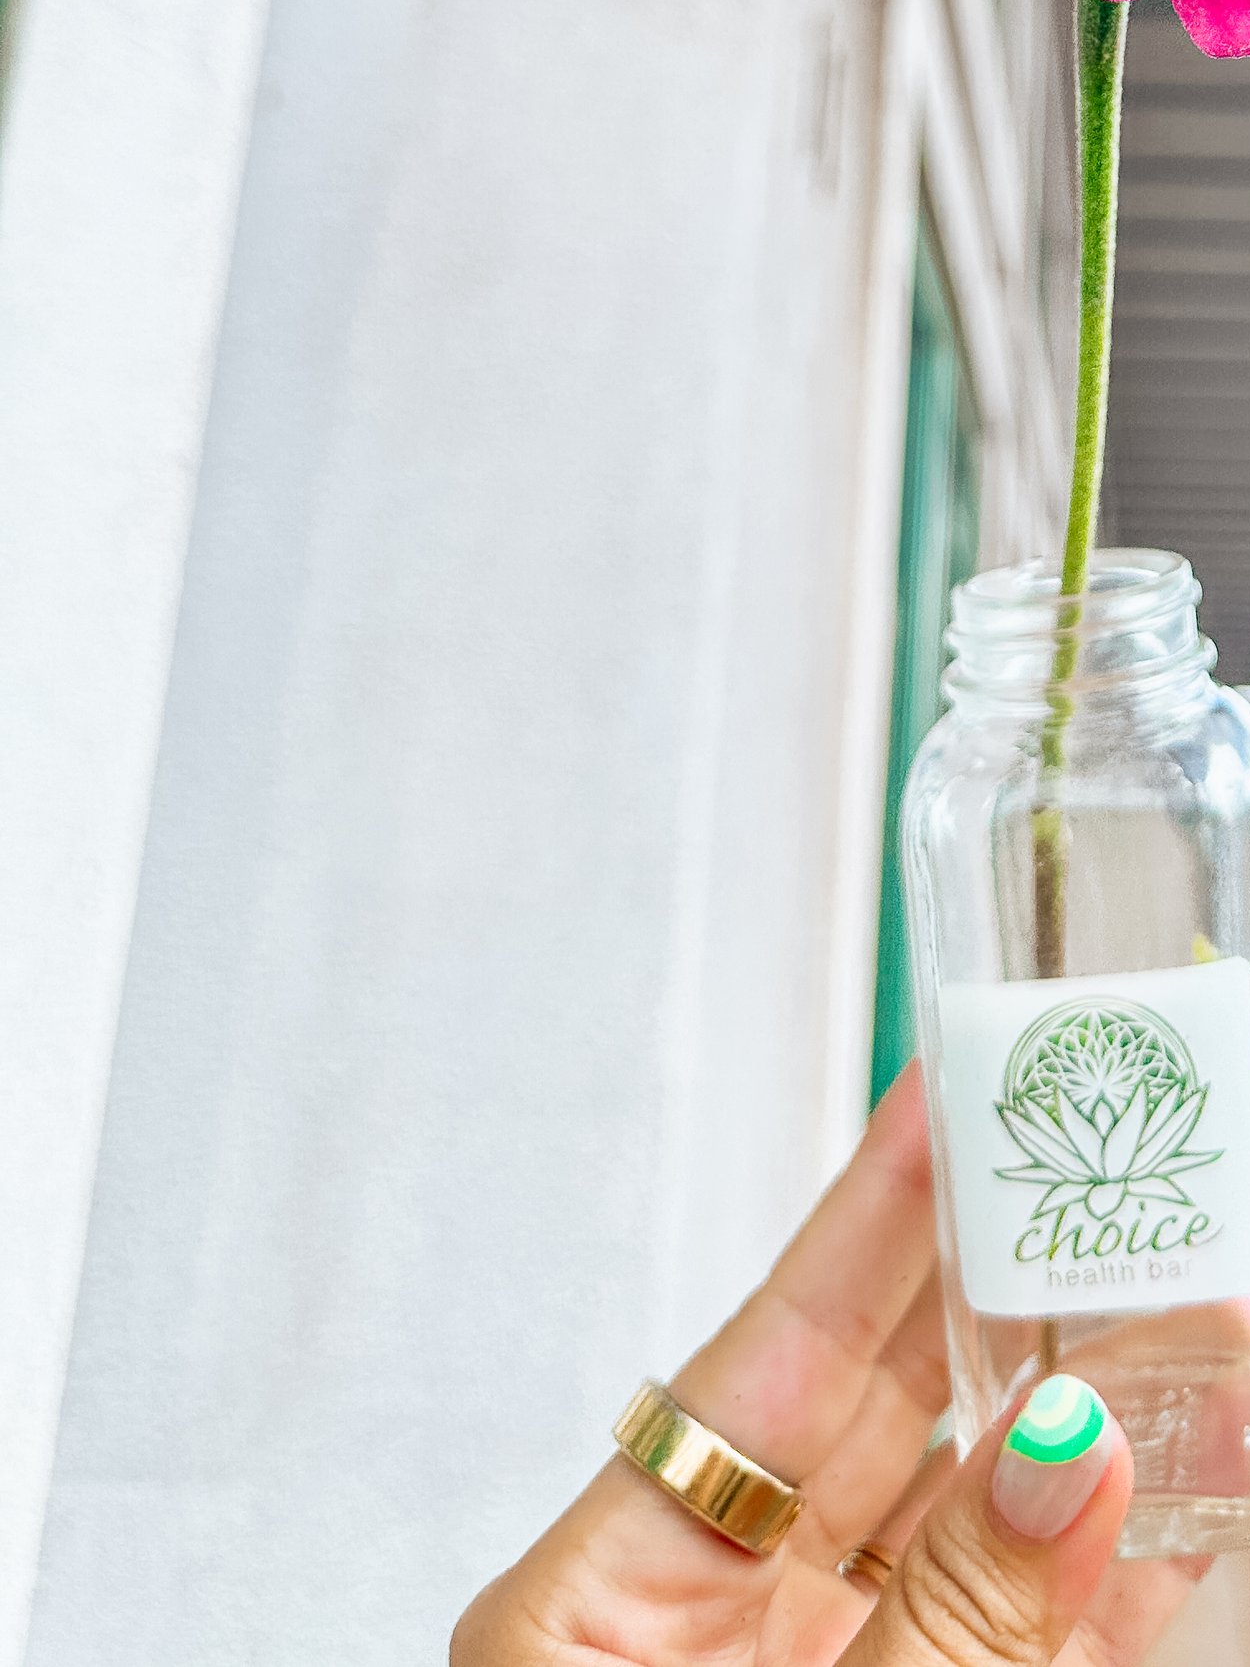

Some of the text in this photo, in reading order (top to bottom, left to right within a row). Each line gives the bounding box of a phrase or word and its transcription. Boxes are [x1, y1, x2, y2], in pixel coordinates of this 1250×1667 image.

[1014, 1201, 1224, 1262] choice
[1047, 1257, 1192, 1288] health bar
